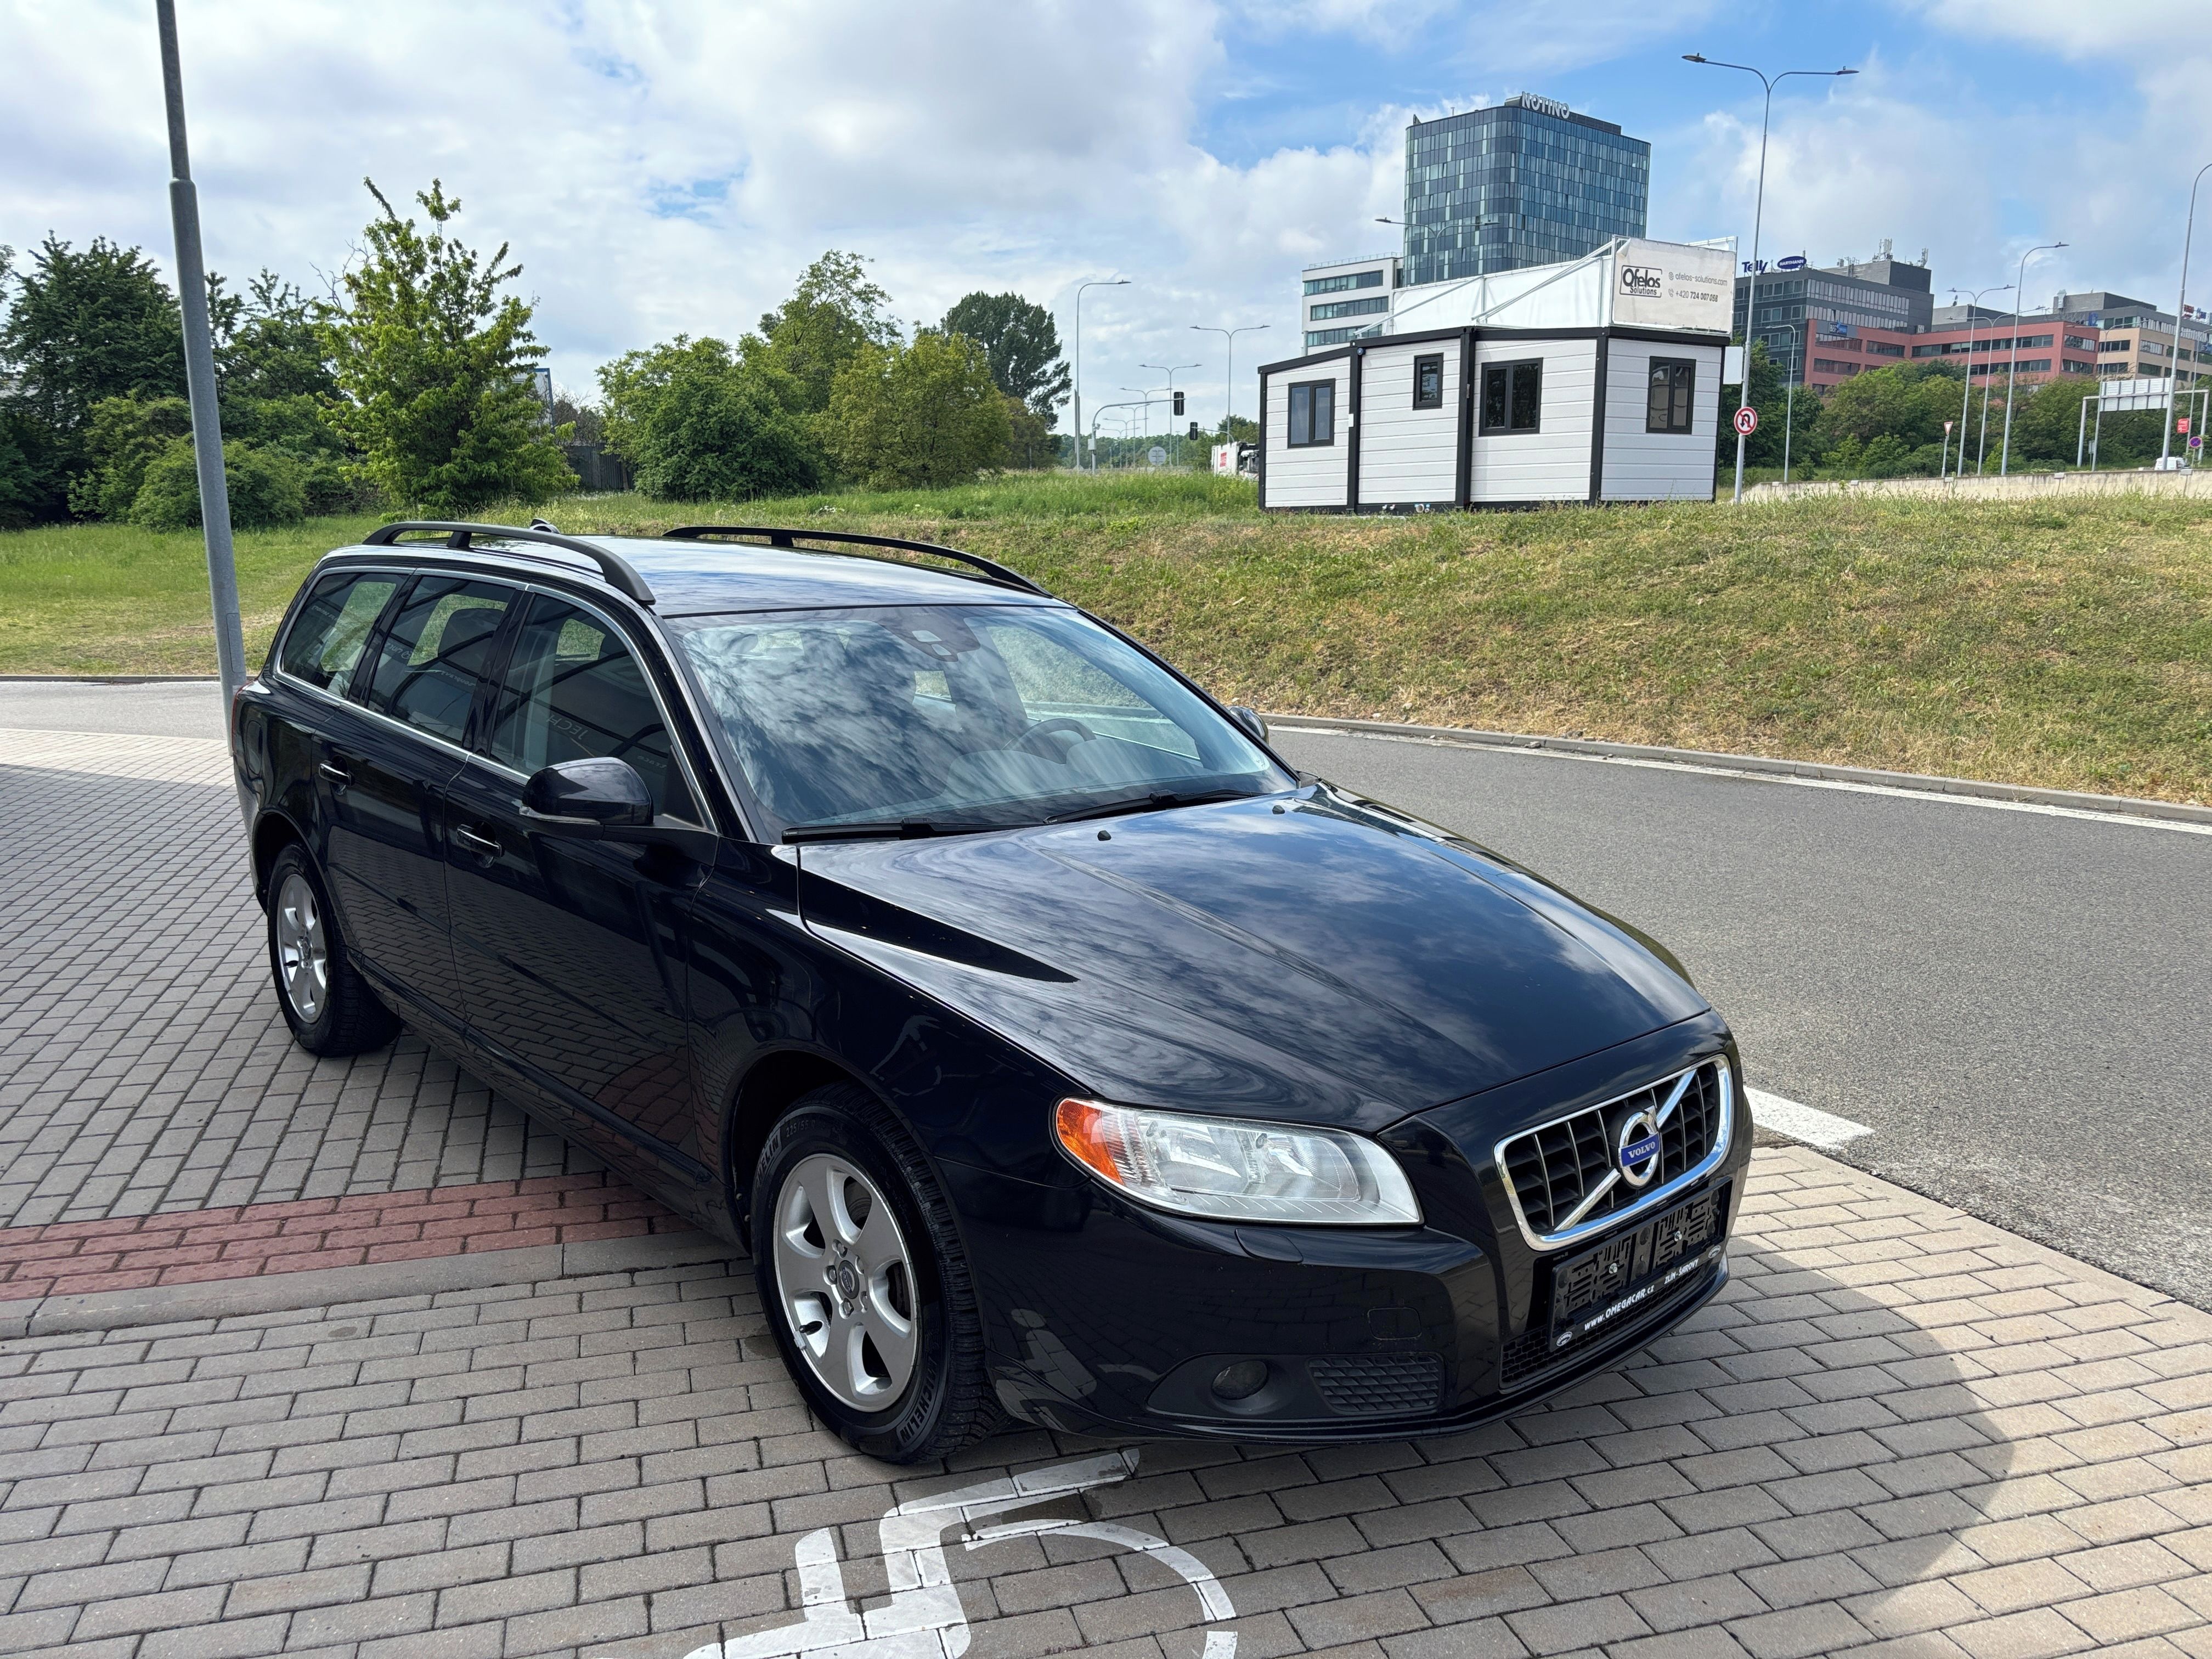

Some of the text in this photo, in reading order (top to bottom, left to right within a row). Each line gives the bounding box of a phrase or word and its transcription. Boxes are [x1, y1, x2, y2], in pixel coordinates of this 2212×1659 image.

[1521, 91, 1570, 119] NOTINO
[1742, 259, 1768, 274] Telly
[1622, 268, 1661, 288] Ofelos
[1675, 273, 1728, 287] ofelos-solutions.com
[1629, 286, 1657, 296] Solutions
[1676, 290, 1689, 298] +420
[1690, 291, 1699, 300] 724
[1700, 292, 1709, 301] 007
[1628, 1141, 1655, 1159] VOLVO
[1584, 1284, 1655, 1331] www.OMEGACAR.cz
